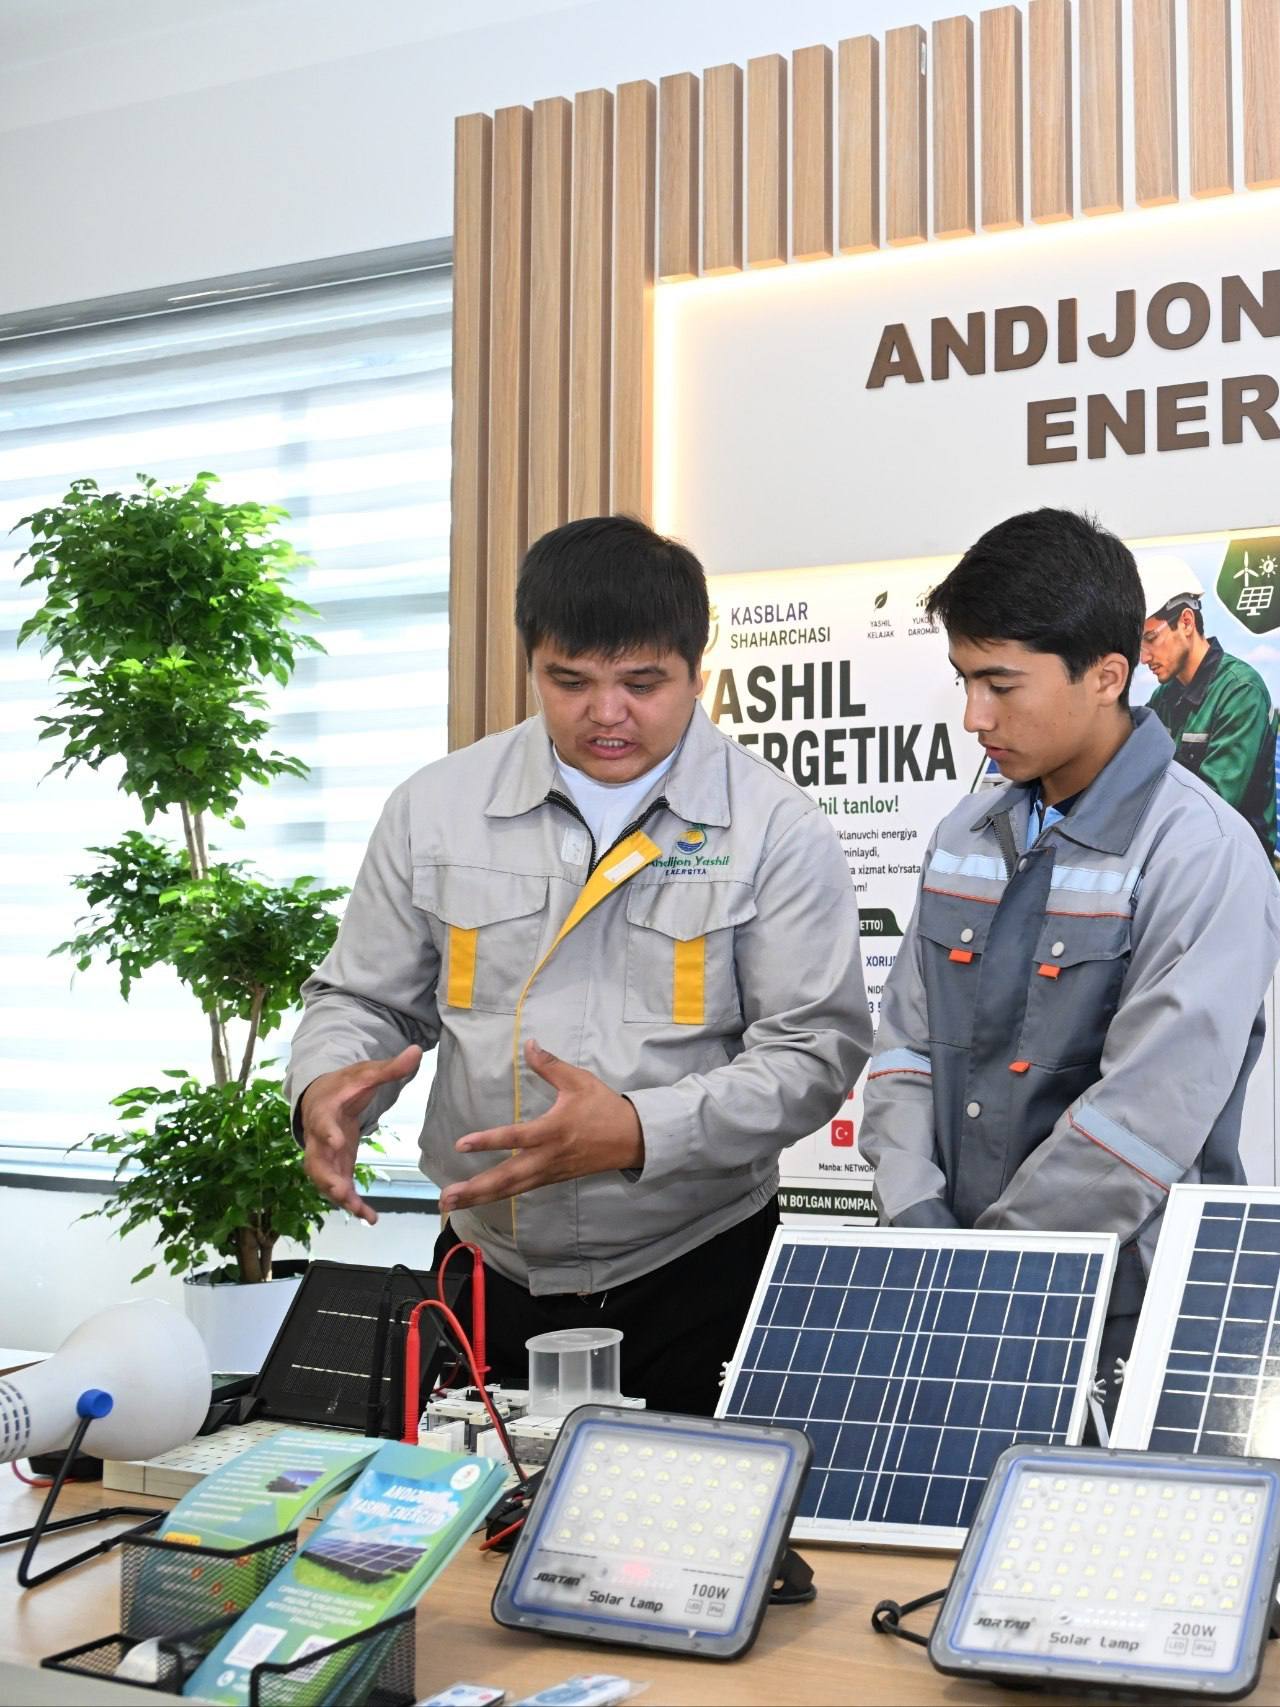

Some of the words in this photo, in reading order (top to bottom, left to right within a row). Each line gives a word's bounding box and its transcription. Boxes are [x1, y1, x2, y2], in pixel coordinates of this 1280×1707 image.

[731, 601, 809, 626] KASBLAR
[730, 626, 831, 649] SHAHARCHASI
[729, 722, 957, 787] RGETIKA
[843, 795, 899, 815] tanlov!
[881, 828, 918, 841] energiya
[858, 865, 886, 875] xizmat
[691, 1583, 730, 1600] 100W
[588, 1591, 624, 1606] Solar
[630, 1596, 663, 1613] Lamp
[1172, 1623, 1216, 1637] 200W
[1049, 1632, 1091, 1646] Solar
[1100, 1636, 1140, 1652] Lamp
